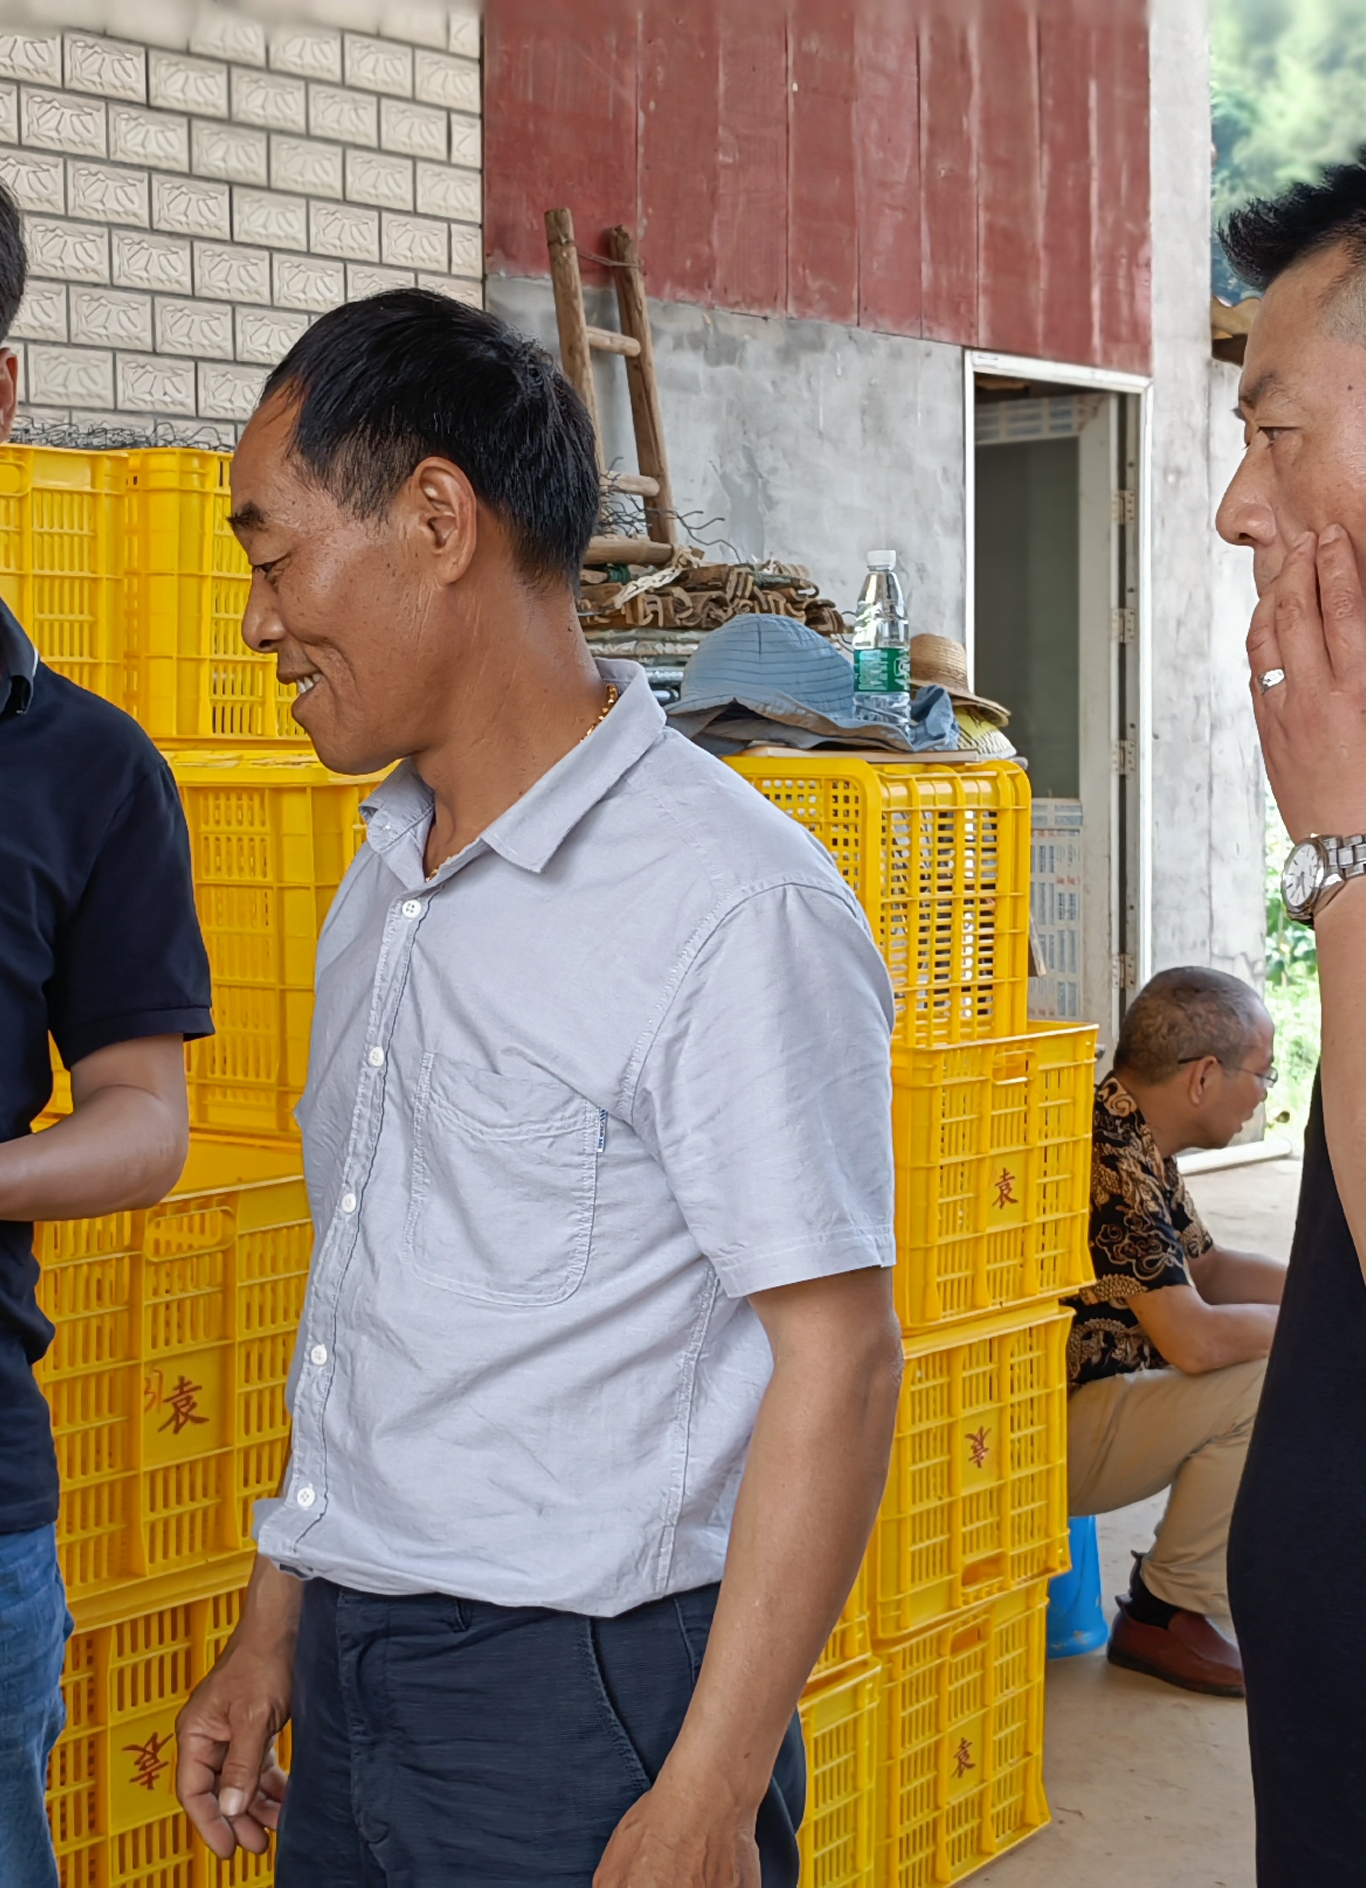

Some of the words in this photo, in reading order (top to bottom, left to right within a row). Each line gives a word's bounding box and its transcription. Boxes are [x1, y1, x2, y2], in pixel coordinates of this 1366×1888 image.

[991, 1167, 1019, 1210] 袁
[157, 1375, 211, 1435] 袁
[964, 1425, 992, 1469] 袁
[121, 1731, 174, 1790] 袁
[950, 1736, 976, 1779] 袁
